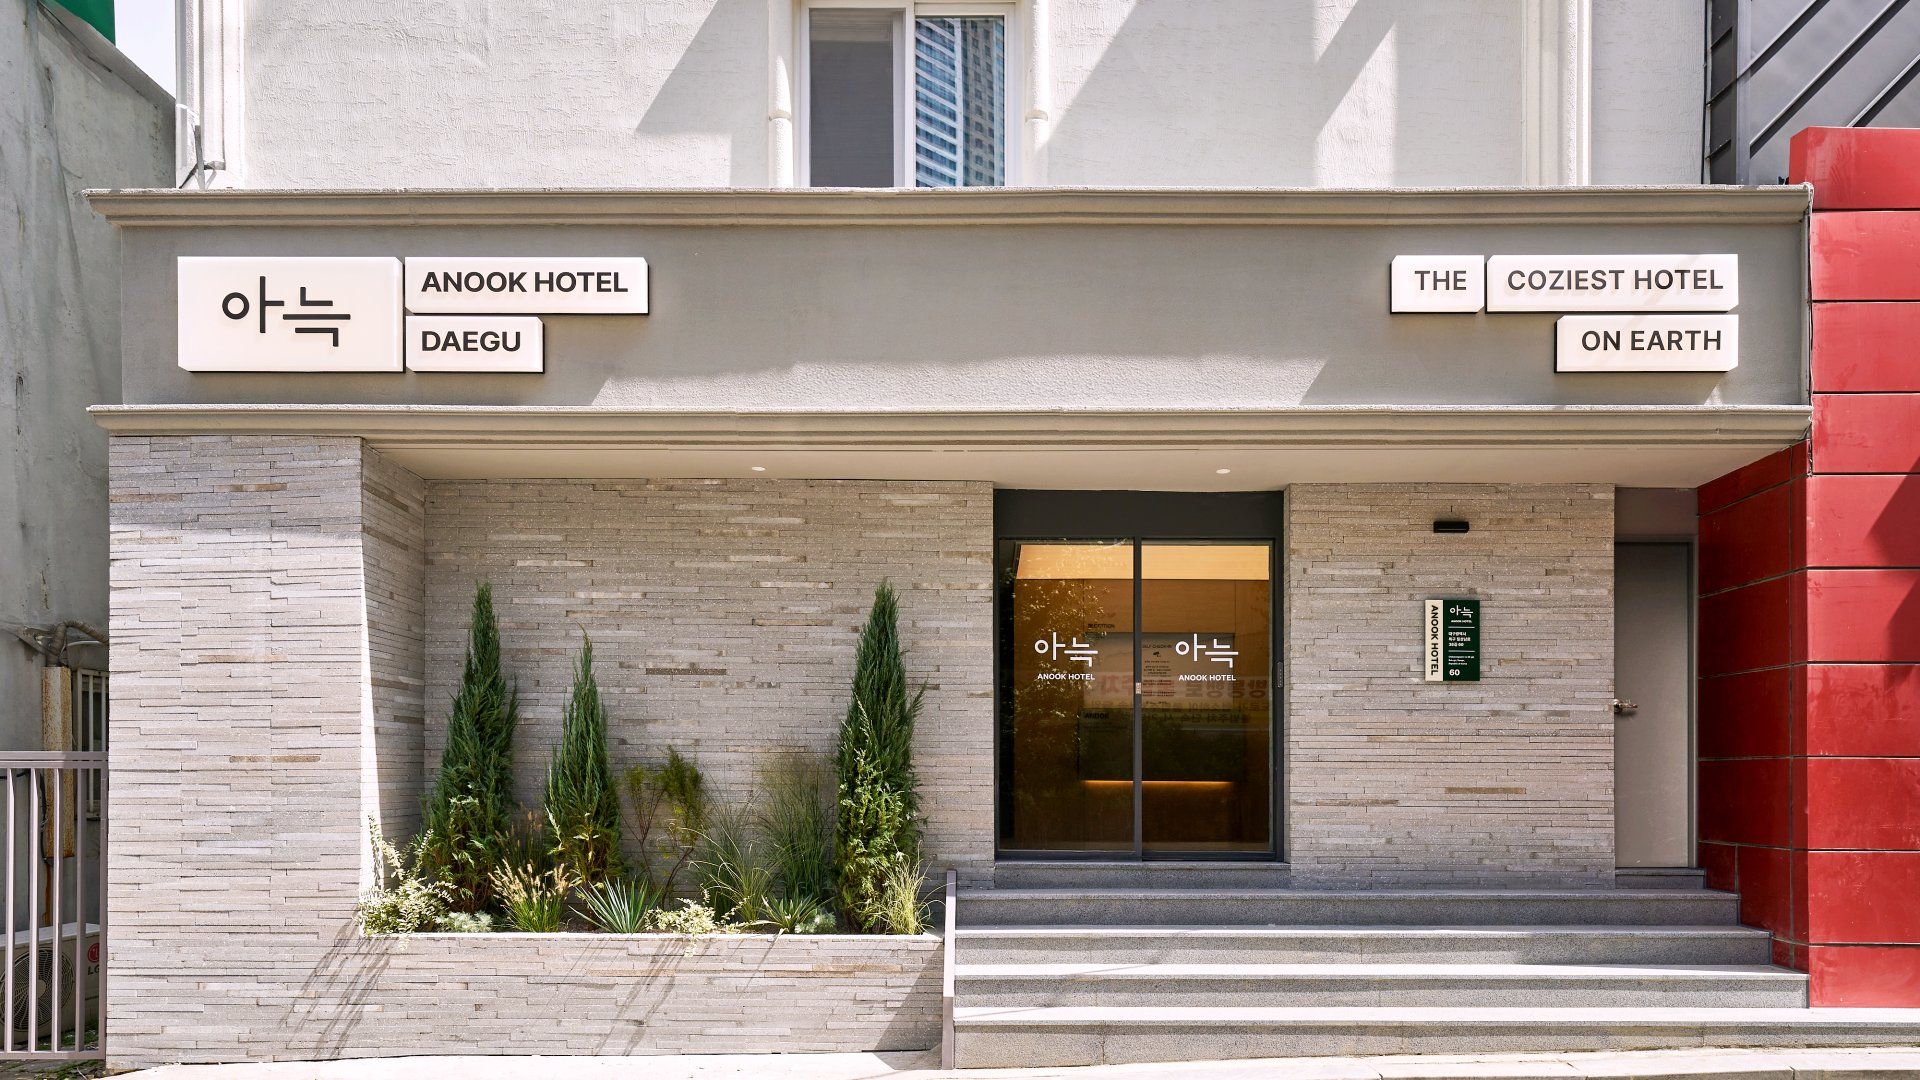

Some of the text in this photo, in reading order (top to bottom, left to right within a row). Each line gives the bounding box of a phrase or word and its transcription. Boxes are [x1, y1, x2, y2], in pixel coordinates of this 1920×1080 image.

[420, 271, 629, 293] ANOOK HOTEL
[1414, 270, 1467, 291] THE
[1507, 269, 1724, 291] COZIEST HOTEL
[221, 275, 352, 348] 아늑
[421, 330, 521, 352] DAEGU
[1581, 330, 1722, 351] ON EARTH
[1450, 605, 1473, 618] 아늑
[1034, 631, 1099, 667] 아늑
[1175, 633, 1239, 669] 아늑
[1431, 605, 1439, 675] ANOOK HOTEL
[1178, 674, 1237, 682] ANOOK HOTEL
